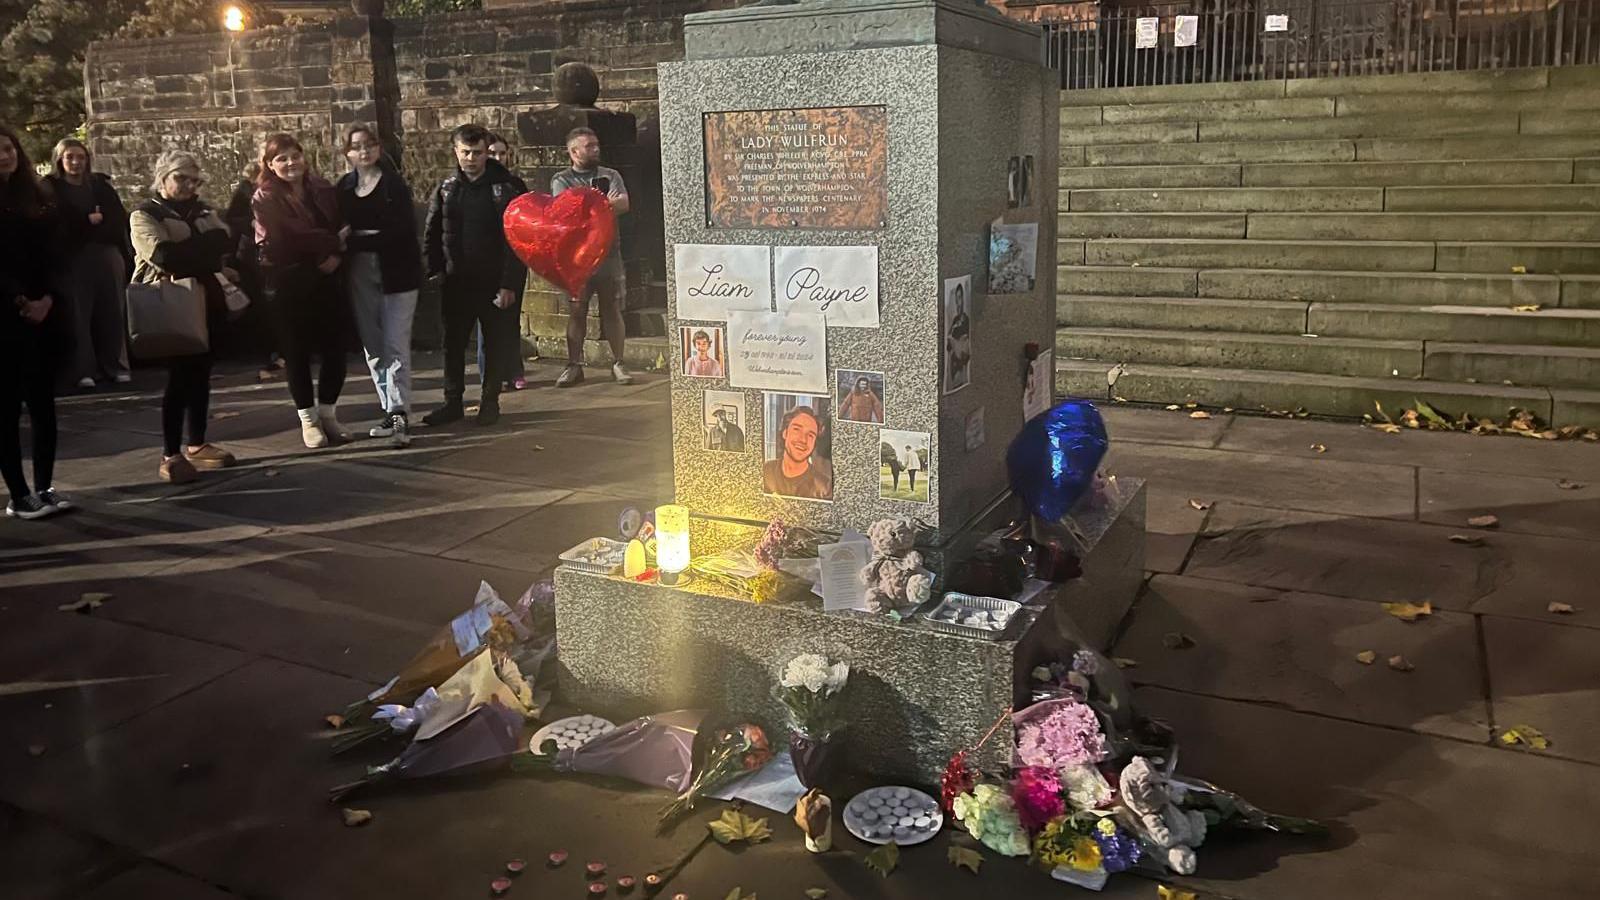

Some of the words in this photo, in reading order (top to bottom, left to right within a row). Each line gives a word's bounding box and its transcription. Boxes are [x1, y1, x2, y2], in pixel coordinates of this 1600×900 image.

[765, 124, 779, 132] THIS
[783, 123, 807, 131] STATUE
[812, 123, 822, 131] OF
[741, 136, 773, 149] LADY
[781, 134, 848, 148] WULFRUN
[822, 194, 862, 202] CENTENARY
[688, 264, 754, 298] Liam
[786, 267, 869, 310] Payne
